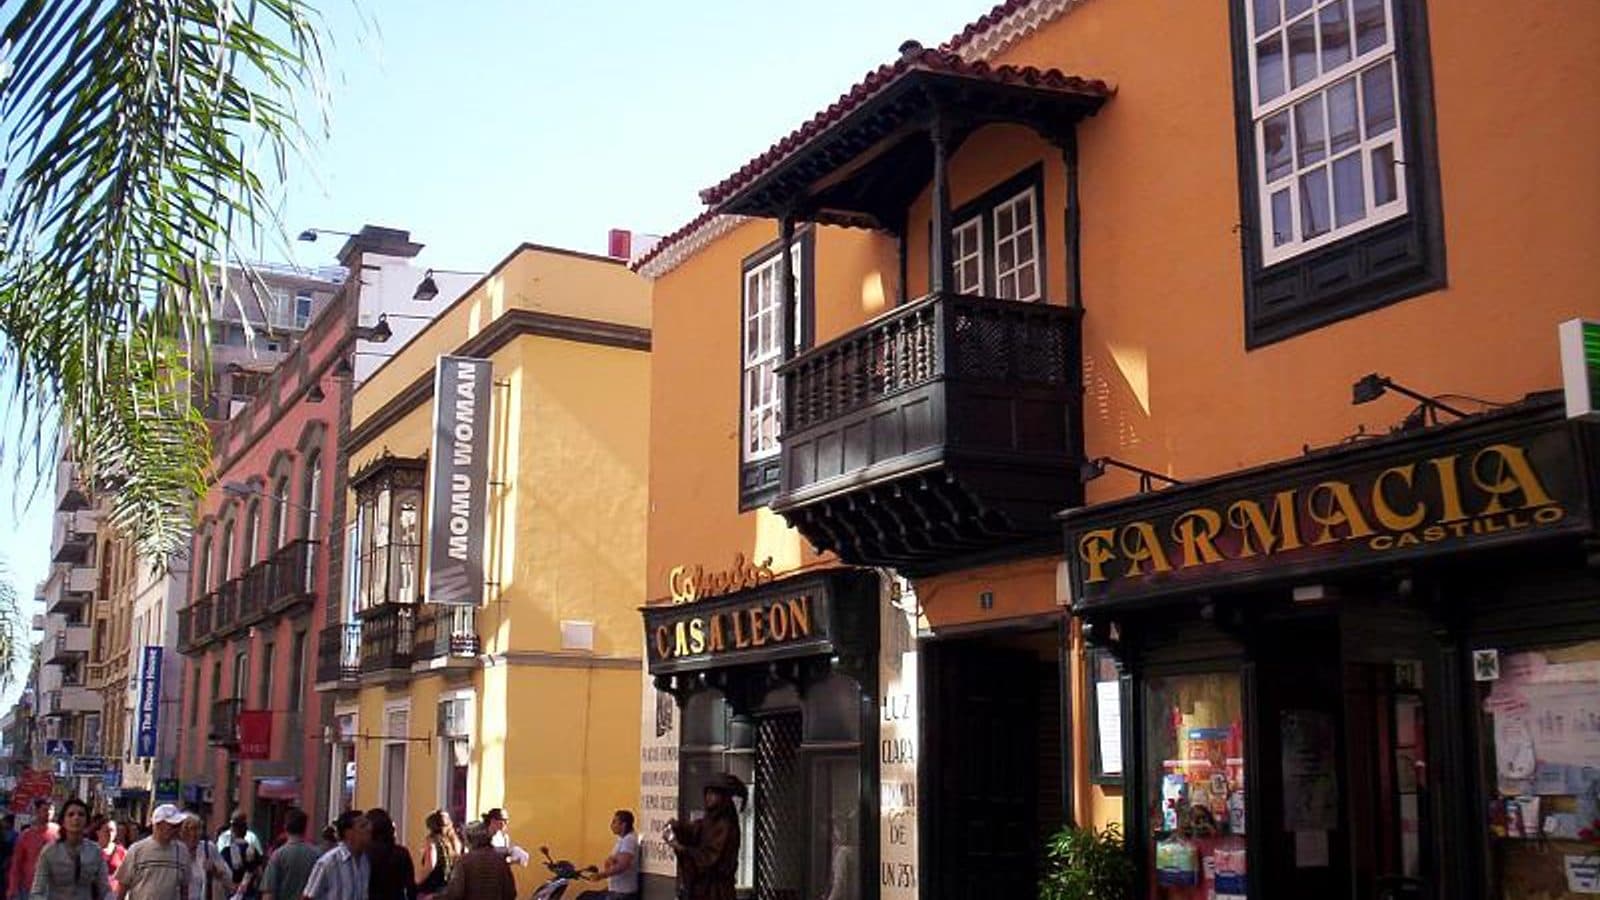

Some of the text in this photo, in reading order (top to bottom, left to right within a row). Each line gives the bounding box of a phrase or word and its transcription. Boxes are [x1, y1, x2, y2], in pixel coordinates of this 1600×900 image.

[448, 362, 477, 560] MOMU WOMAN
[1077, 442, 1554, 584] FARMACIA
[1368, 504, 1566, 551] CASTILLO
[655, 594, 811, 659] CASA LEON
[881, 737, 916, 765] CLARA
[889, 823, 907, 845] DE
[881, 861, 895, 888] UN
